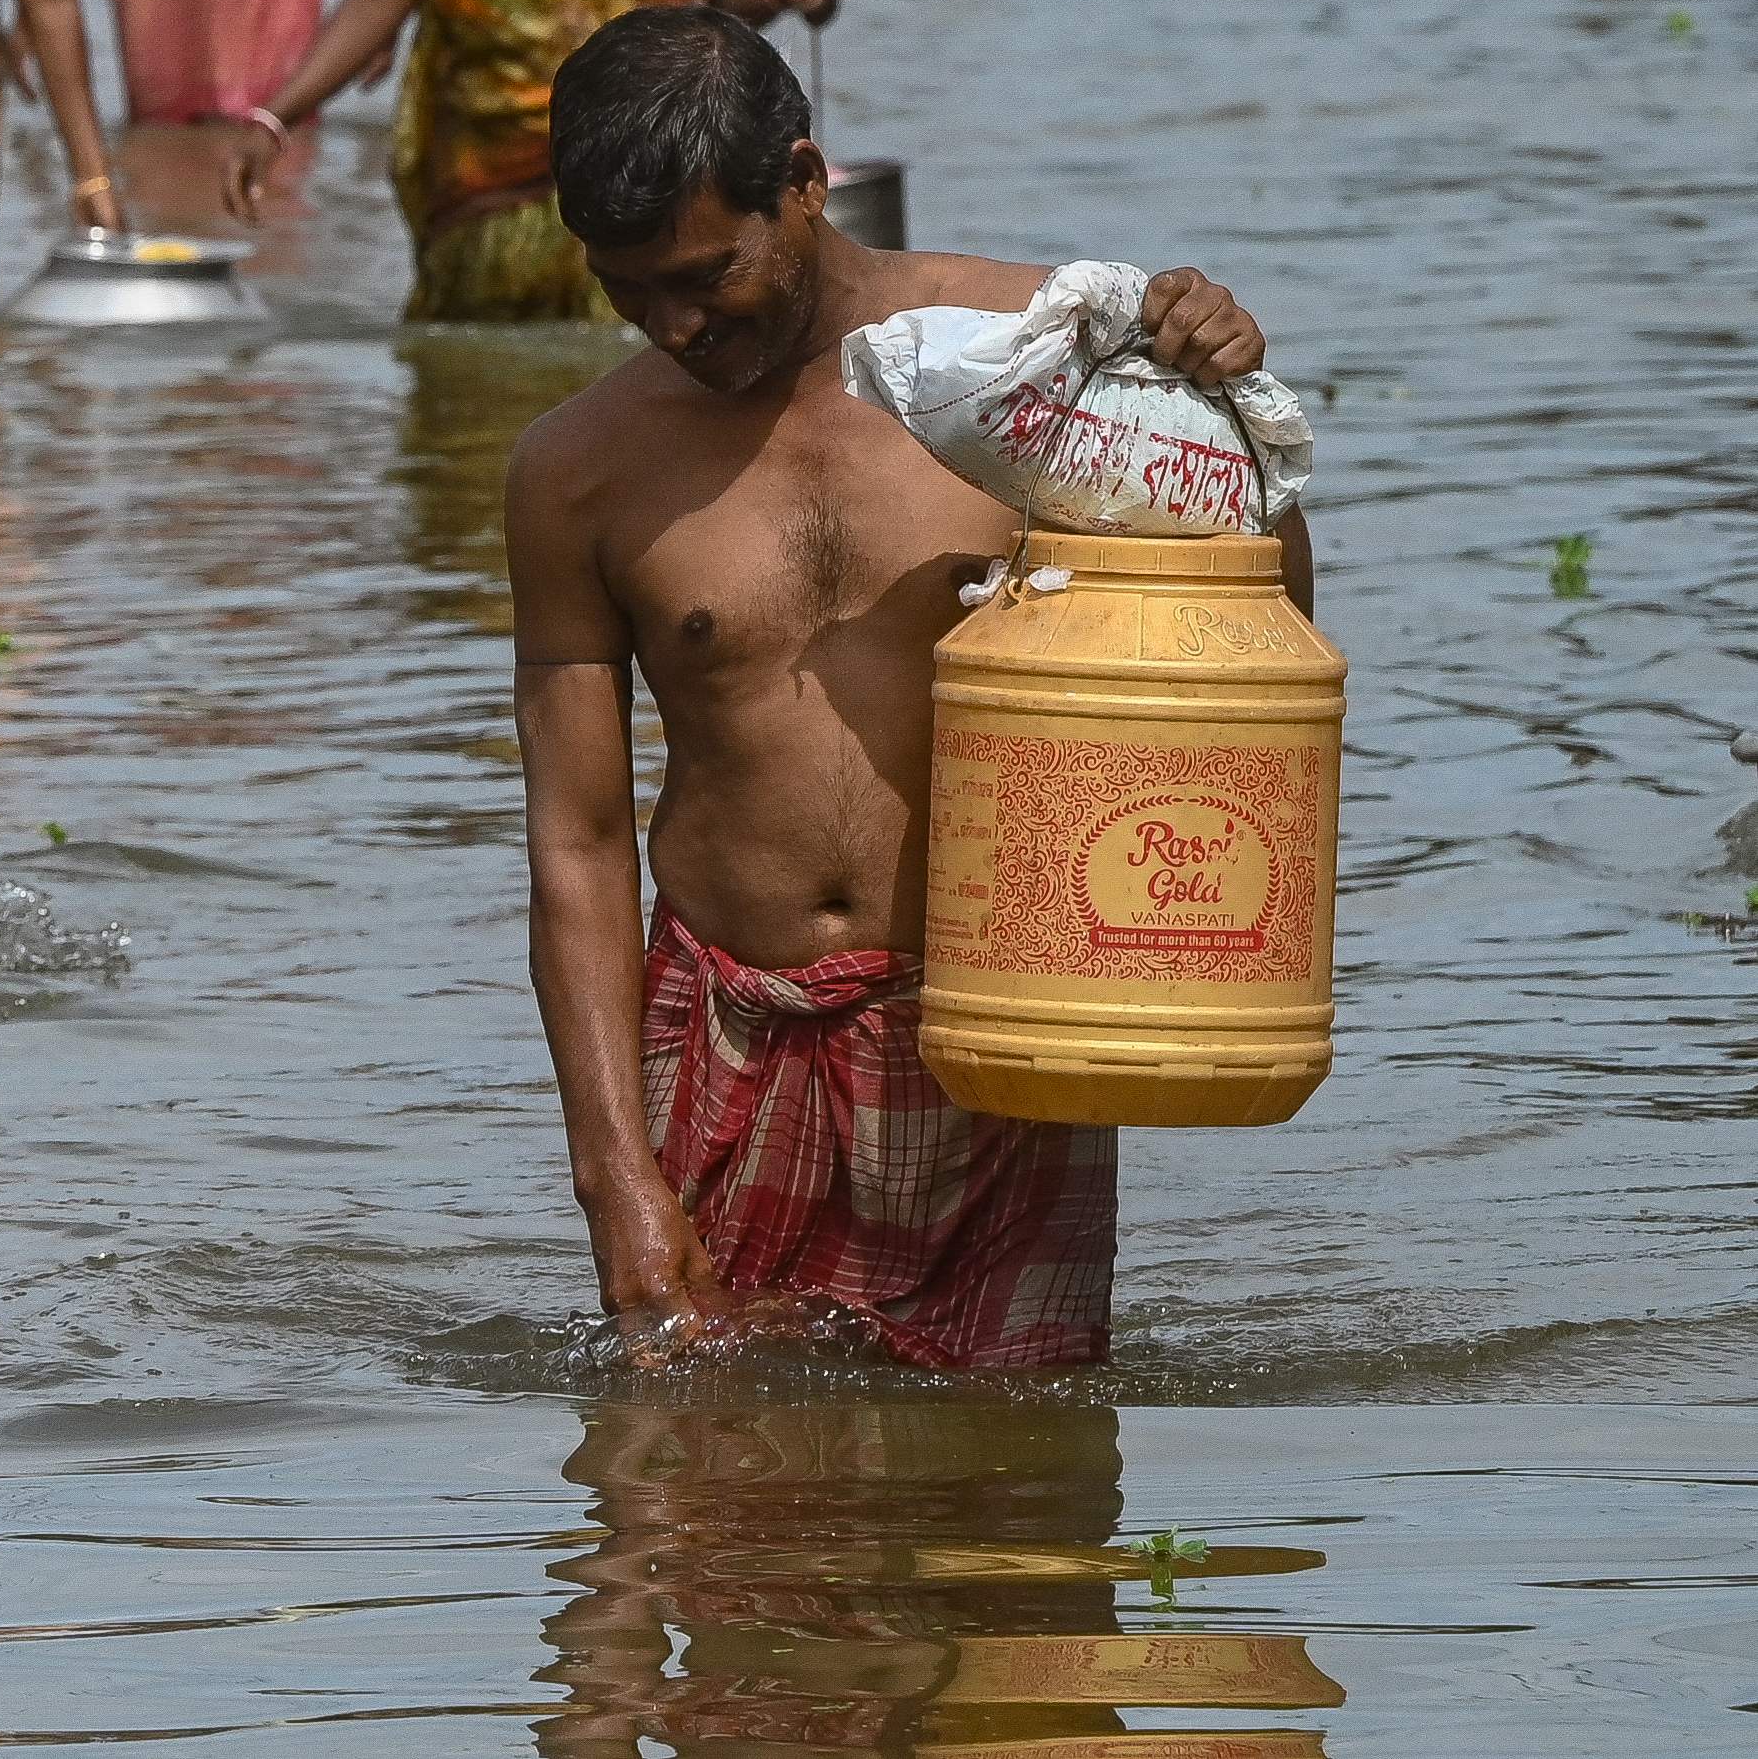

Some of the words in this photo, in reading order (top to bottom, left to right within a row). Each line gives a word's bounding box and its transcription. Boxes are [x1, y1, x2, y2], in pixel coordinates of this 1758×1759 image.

[1147, 869, 1223, 911] Gold
[1131, 911, 1235, 927] VANASPATI
[1097, 930, 1137, 945] Trusted
[1140, 932, 1155, 945] for
[1158, 934, 1185, 947] more
[1187, 933, 1211, 947] than
[1214, 933, 1227, 947] 60
[1228, 935, 1254, 948] years
